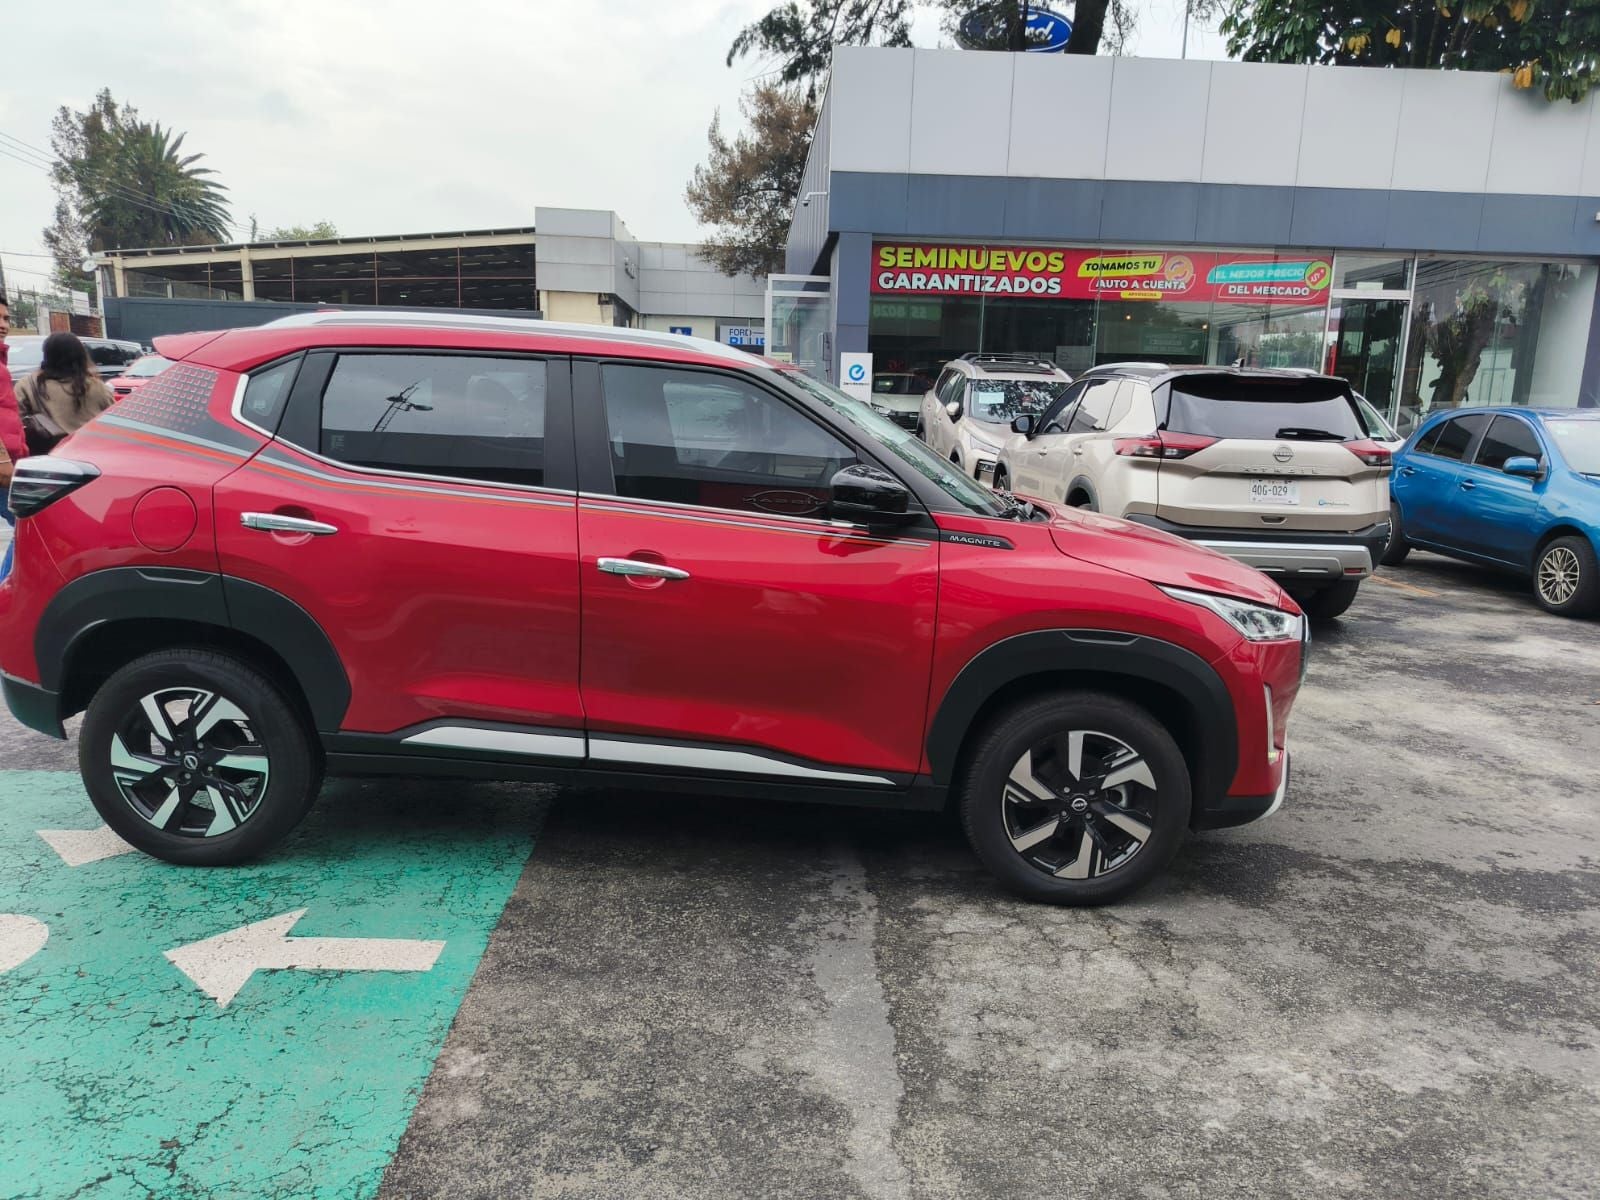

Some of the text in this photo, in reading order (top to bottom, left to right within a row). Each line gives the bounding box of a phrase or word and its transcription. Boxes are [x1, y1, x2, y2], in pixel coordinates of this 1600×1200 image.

[879, 246, 1065, 273] SEMINUEVOS
[1085, 260, 1156, 271] TOMAMOS TU
[1215, 268, 1305, 279] EL MEJOR PRECIO
[878, 271, 1062, 294] GARANTIZADOS
[1095, 279, 1187, 290] AUTO A CUENTA
[1228, 285, 1310, 296] DEL MERCADO
[729, 328, 752, 337] FORD
[949, 535, 1001, 547] MAGNITE
